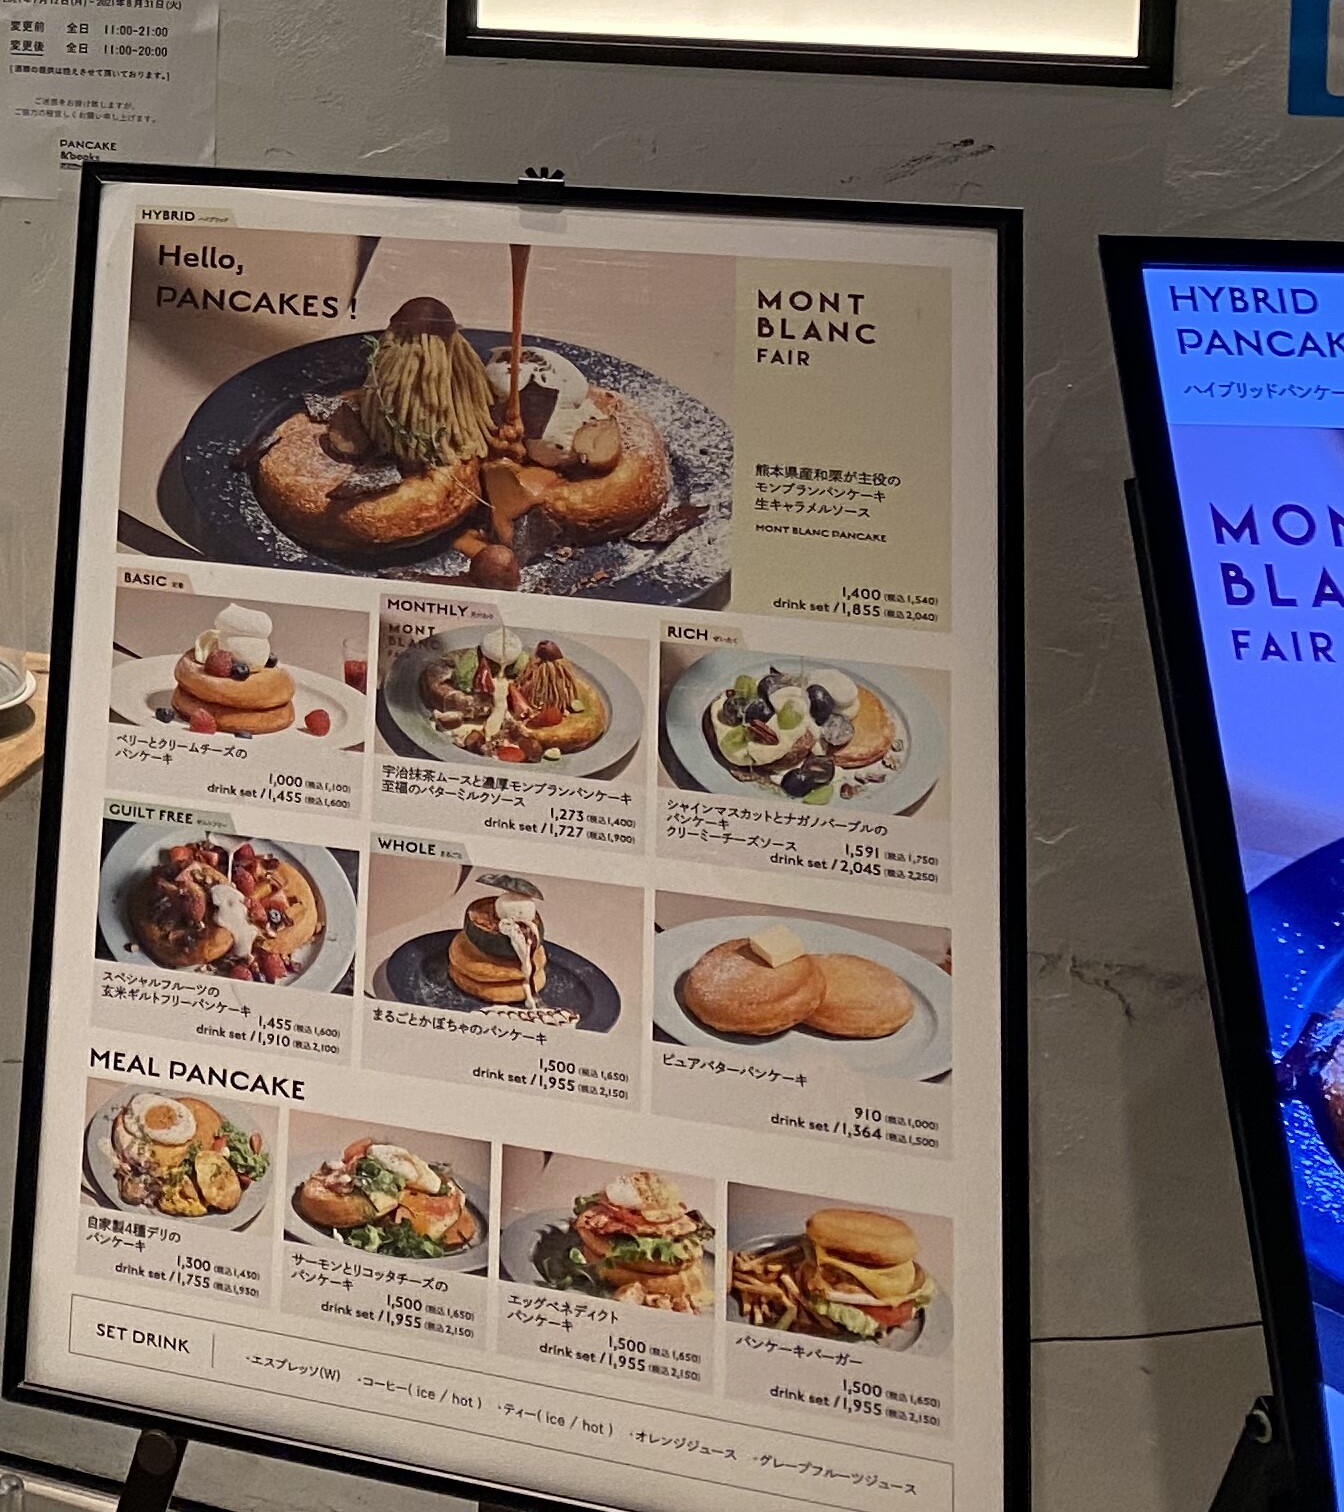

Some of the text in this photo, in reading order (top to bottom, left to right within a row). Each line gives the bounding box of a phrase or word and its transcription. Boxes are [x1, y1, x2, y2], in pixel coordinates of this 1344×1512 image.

[11, 21, 168, 37] 変更前 全日 11:00-21:00
[11, 40, 168, 58] 変更後 全日 11:00-20:00
[60, 139, 117, 151] PANCAKE
[142, 210, 195, 222] HYBRID
[159, 244, 244, 275] Hello,
[157, 286, 339, 318] PANCAKES
[758, 289, 865, 315] MONT
[1168, 285, 1319, 314] HYBRID
[758, 317, 876, 344] BLANC
[757, 348, 809, 366] FAIR
[755, 463, 901, 488] 熊本県産和栗が主役の
[756, 482, 886, 502] モンブランパンケーキ
[754, 498, 871, 518] 生キャラメルソース
[756, 524, 887, 542] MONT BLANC PANCAKE
[124, 572, 167, 587] BASIC
[843, 586, 881, 601] 1,400
[387, 599, 469, 617] MONTHLY
[773, 598, 830, 612] drink set
[667, 626, 708, 640] RICH
[1231, 628, 1336, 663] FAIR
[115, 748, 173, 765] パンケーキ
[117, 735, 247, 759] ベリーとクリームチーズの
[269, 773, 302, 789] 1,000
[382, 764, 632, 806] 宇治抹茶ムースと濃厚モンブランパンケーキ
[207, 783, 257, 799] drink set
[381, 780, 526, 807] 至福のバターミルクソース
[109, 803, 193, 824] GUILT FREE
[550, 808, 584, 823] 1,273
[667, 799, 888, 836] シャインマスカットとナガノパープルの
[667, 814, 729, 830] パンケーキ
[484, 817, 538, 833] drink set
[378, 837, 436, 856] WHOLE
[667, 826, 797, 851] クリーミーチーズソース
[845, 843, 880, 859] 1,591
[770, 853, 828, 870] drink set
[102, 971, 220, 997] スペシャルフルーツの
[102, 985, 251, 1017] 玄米ギルトフリーパンケーキ
[196, 1024, 247, 1042] drink set
[259, 1015, 291, 1032] 1,455
[373, 1007, 547, 1045] まるごとかぼちゃのパンケーキ
[90, 1047, 305, 1100] MEAL PANCAKE
[473, 1067, 528, 1085] drink set
[539, 1058, 576, 1075] 1,500
[663, 1053, 807, 1087] ピュアバターパンケーキ
[771, 1114, 829, 1132] drink set
[854, 1107, 882, 1122] 910
[87, 1216, 181, 1243] 自家製4種デリの
[86, 1233, 146, 1253] パンケーキ
[115, 1262, 166, 1281] drink set
[177, 1255, 211, 1272] 1,300
[292, 1253, 448, 1292] サーモンとリコッタチーズの
[291, 1268, 354, 1291] パンケーキ
[321, 1302, 374, 1320] drink set
[387, 1294, 422, 1312] 1,500
[508, 1294, 619, 1324] エッグベネディクト
[507, 1310, 573, 1332] パンケーキ
[96, 1323, 190, 1354] SET DRINK
[609, 1336, 646, 1353] 1,500
[539, 1343, 596, 1362] drink set
[736, 1336, 862, 1366] パンケーキバーガー
[770, 1385, 829, 1406] drink set
[843, 1379, 882, 1397] 1,500
